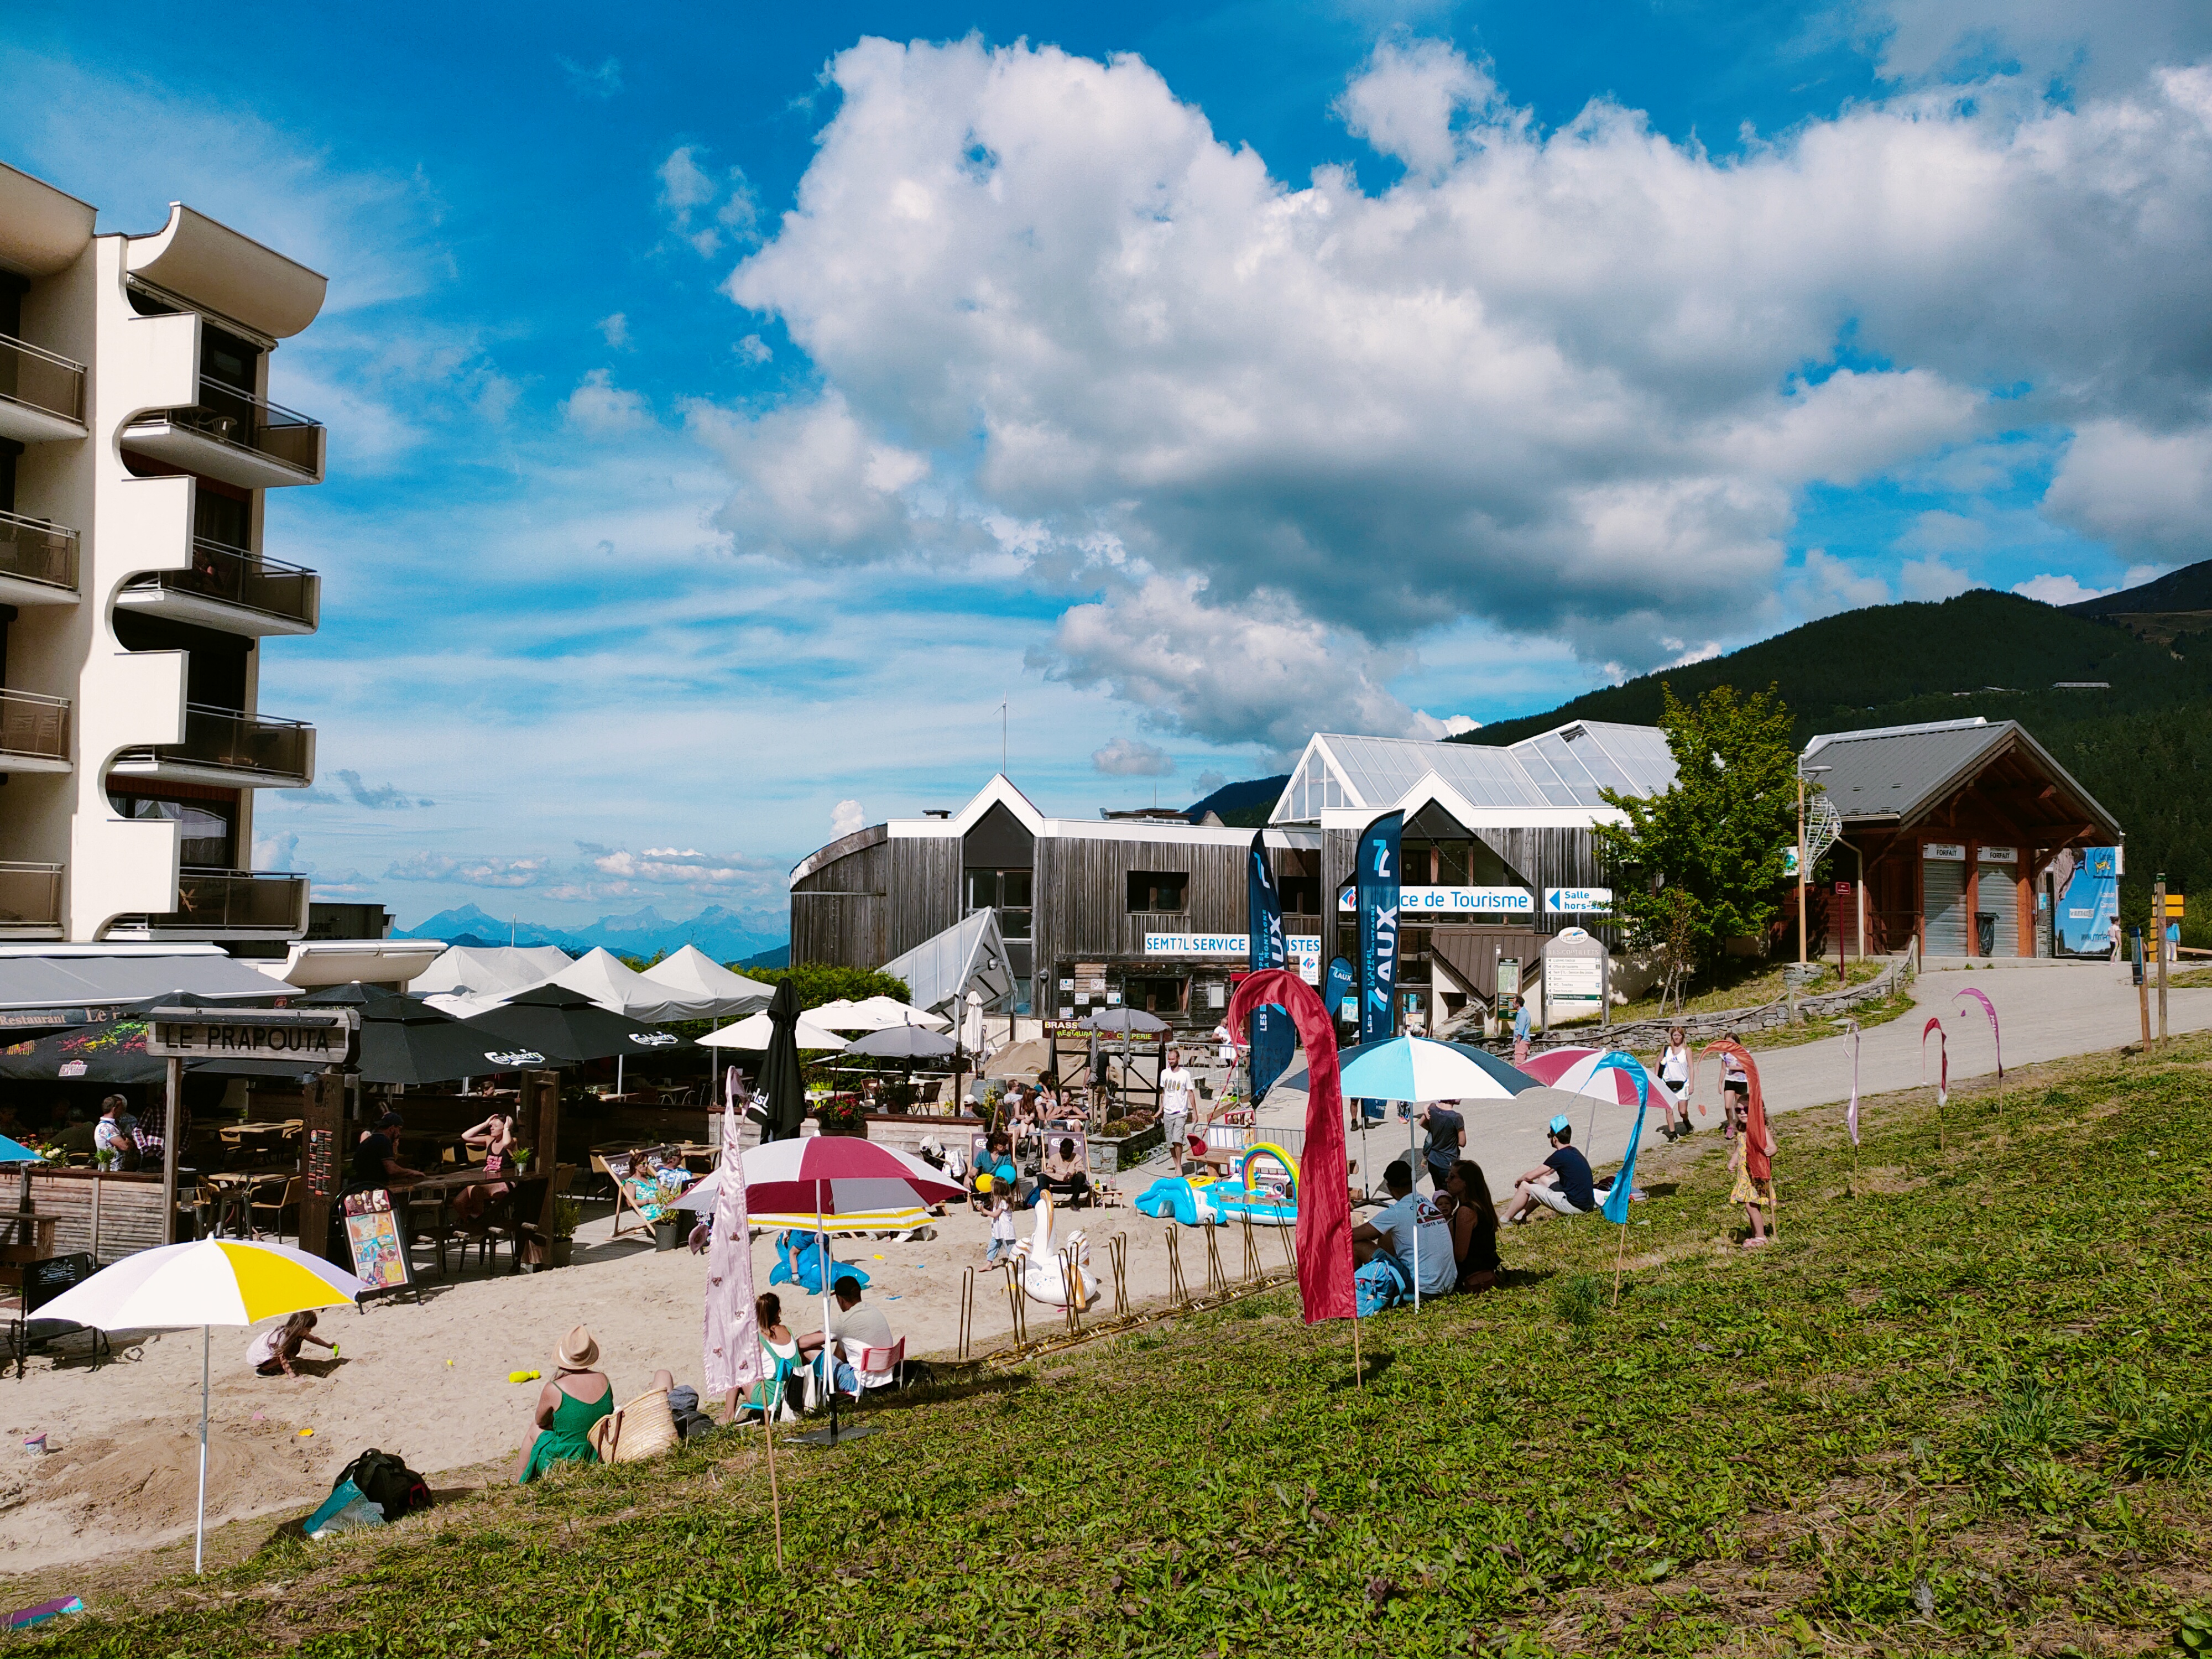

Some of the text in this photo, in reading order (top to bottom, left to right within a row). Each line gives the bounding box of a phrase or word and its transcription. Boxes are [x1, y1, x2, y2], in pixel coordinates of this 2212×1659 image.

[1400, 891, 1528, 908] ce de Tourisme
[1564, 891, 1590, 899] Salle
[1146, 937, 1319, 952] SEMT7L SERVICE ISTES
[0, 1014, 66, 1024] Restaurant
[84, 1006, 107, 1022] Le
[165, 1025, 329, 1052] LE PRAPOUTA
[628, 1031, 679, 1046] Carlsberg
[484, 1049, 546, 1066] Carlsberg
